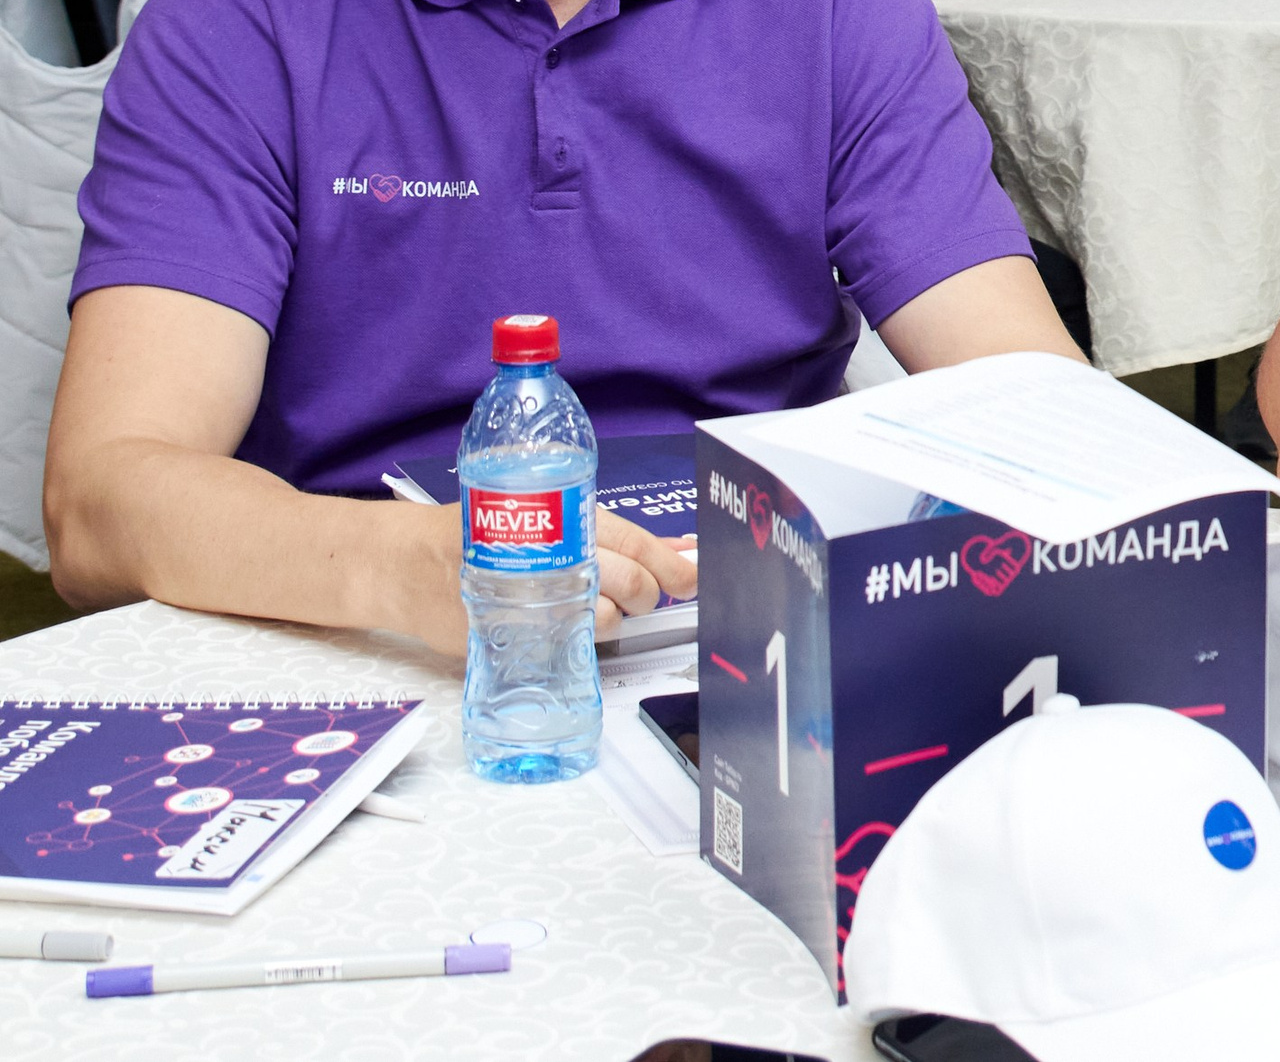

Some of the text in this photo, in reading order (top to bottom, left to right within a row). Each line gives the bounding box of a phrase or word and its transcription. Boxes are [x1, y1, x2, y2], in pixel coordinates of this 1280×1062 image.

[402, 179, 480, 199] КОМАНДА
[476, 506, 555, 532] MEVER
[709, 469, 824, 598] #МЫ КОМАНДА
[865, 517, 1230, 605] #МЫ КОМАНДА
[765, 629, 790, 797] 1
